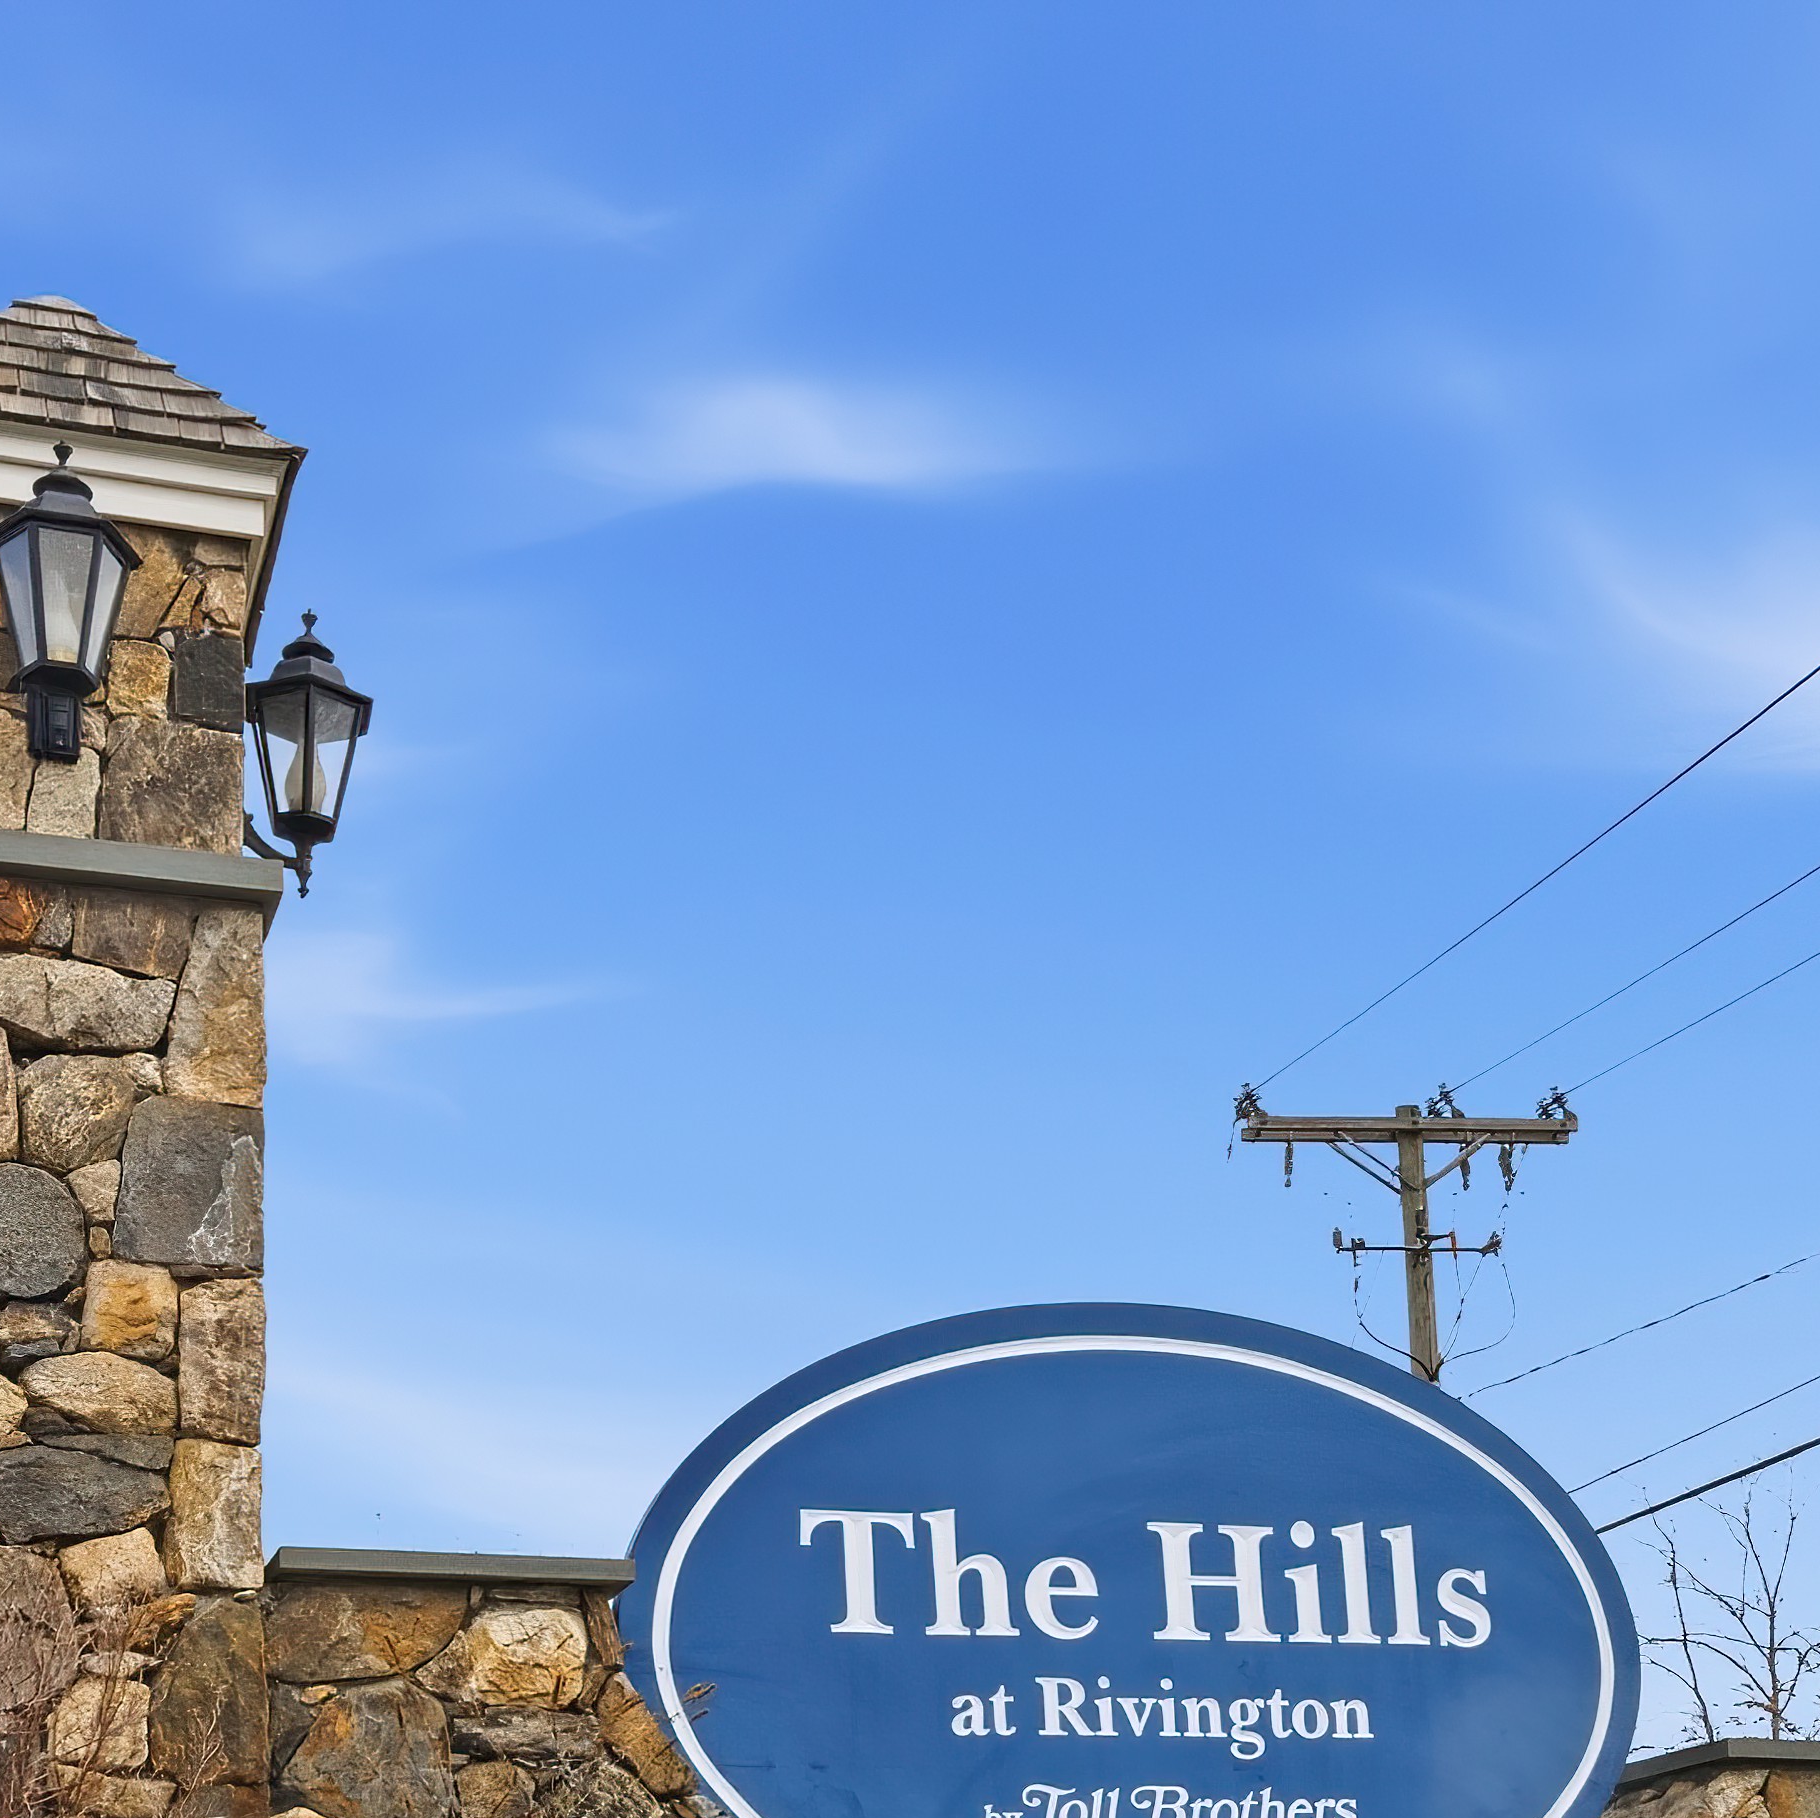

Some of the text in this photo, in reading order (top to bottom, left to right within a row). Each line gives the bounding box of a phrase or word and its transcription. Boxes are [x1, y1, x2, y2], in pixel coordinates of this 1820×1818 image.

[799, 1508, 1492, 1649] The Hills
[951, 1675, 1376, 1760] at Rivington
